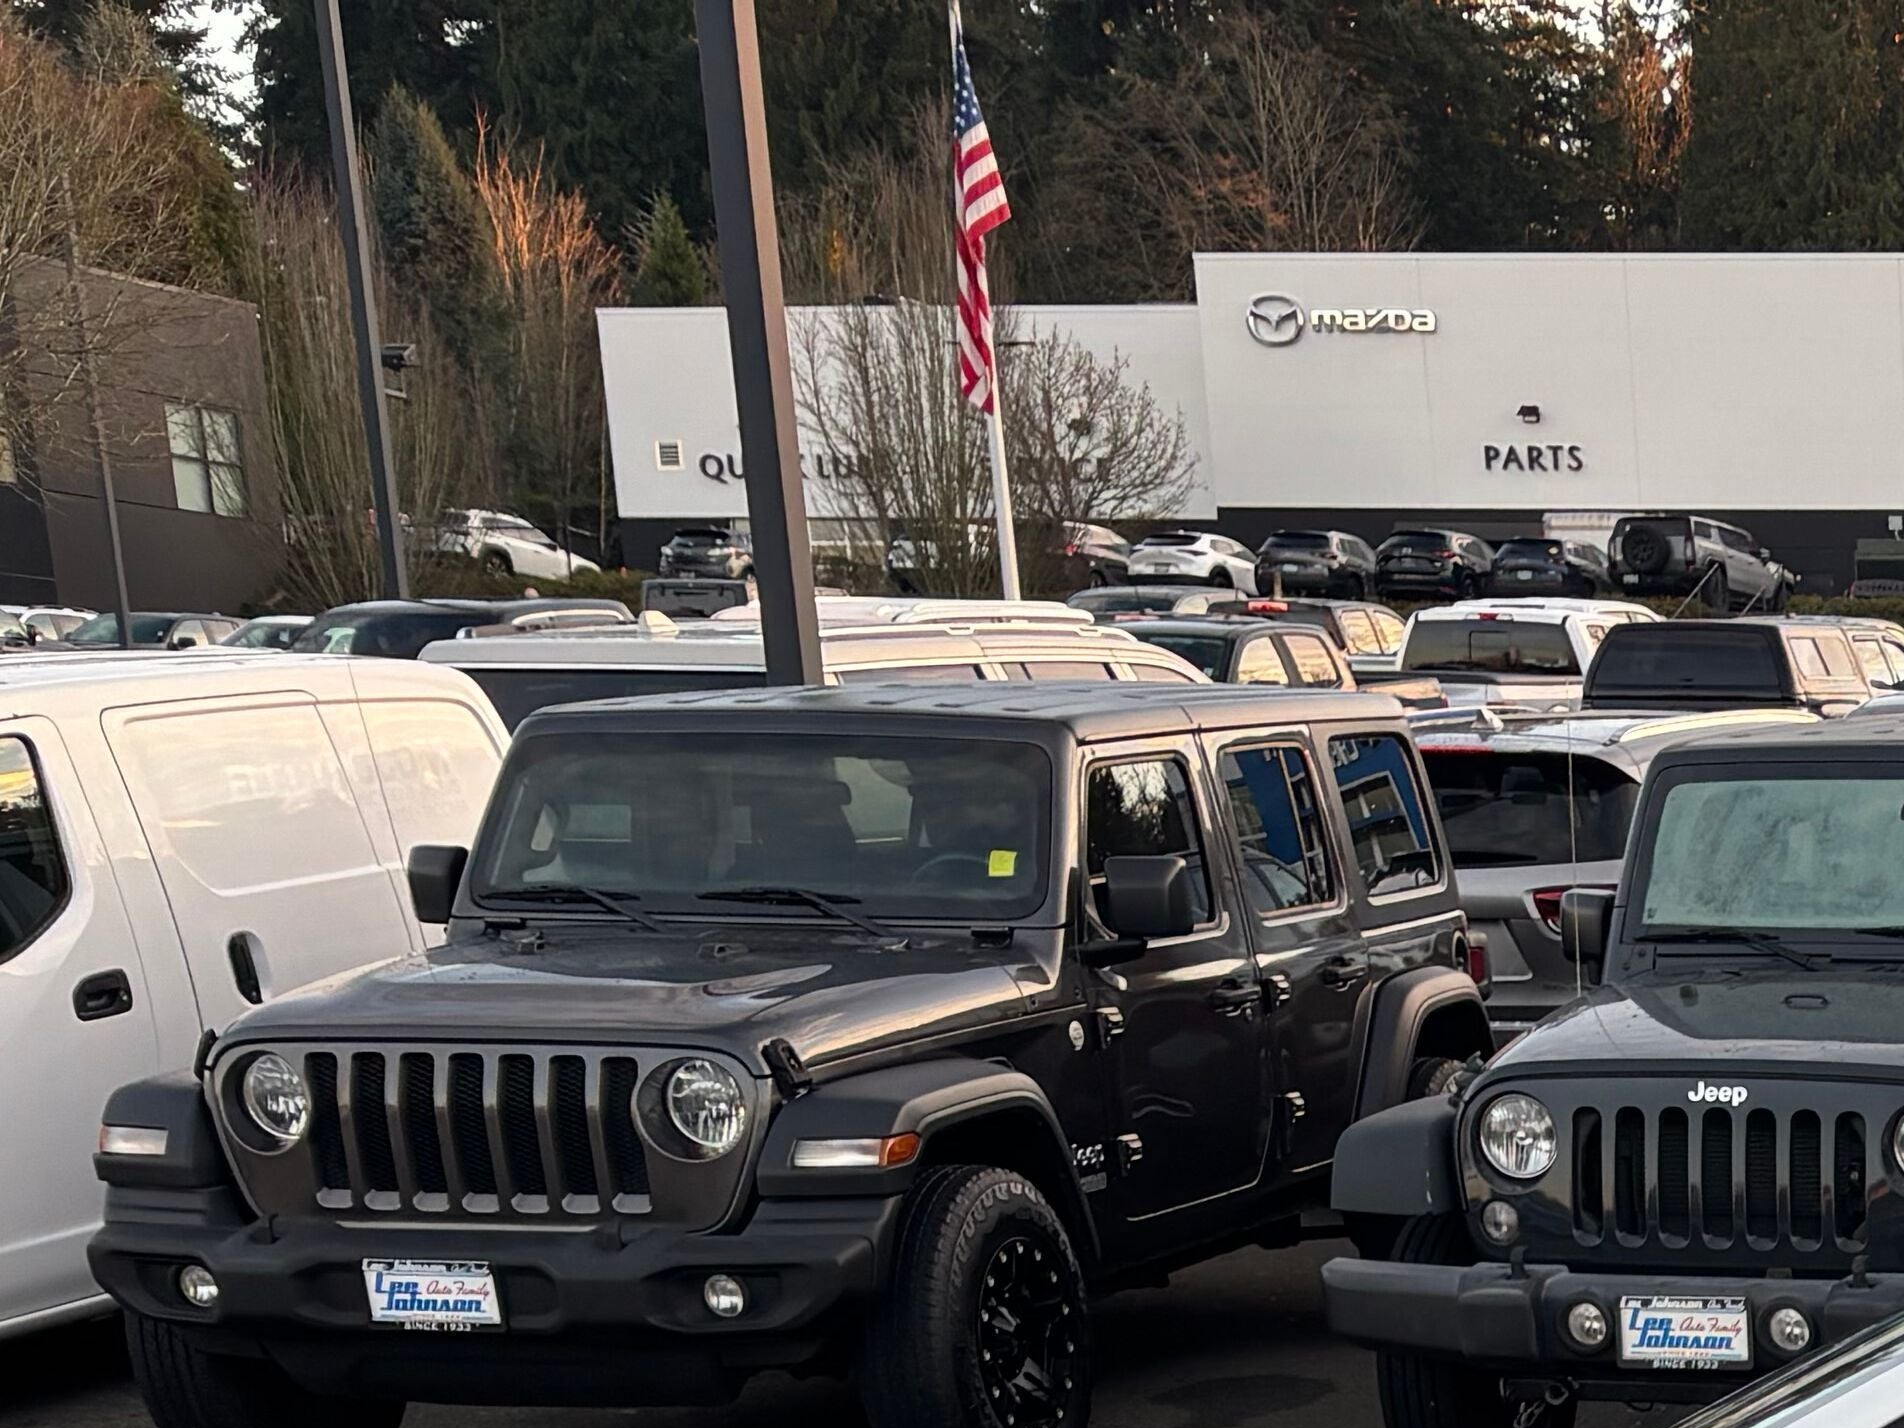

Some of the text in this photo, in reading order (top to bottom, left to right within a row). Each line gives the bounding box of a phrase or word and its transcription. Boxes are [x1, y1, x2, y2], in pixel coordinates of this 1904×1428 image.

[1483, 444, 1584, 472] PARTS
[1687, 1080, 1748, 1107] Jeep
[375, 1271, 490, 1300] Lee Auto Family
[380, 1288, 487, 1313] Johnson
[1629, 1307, 1743, 1337] Lee Auto Family
[1632, 1326, 1735, 1350] Johnson
